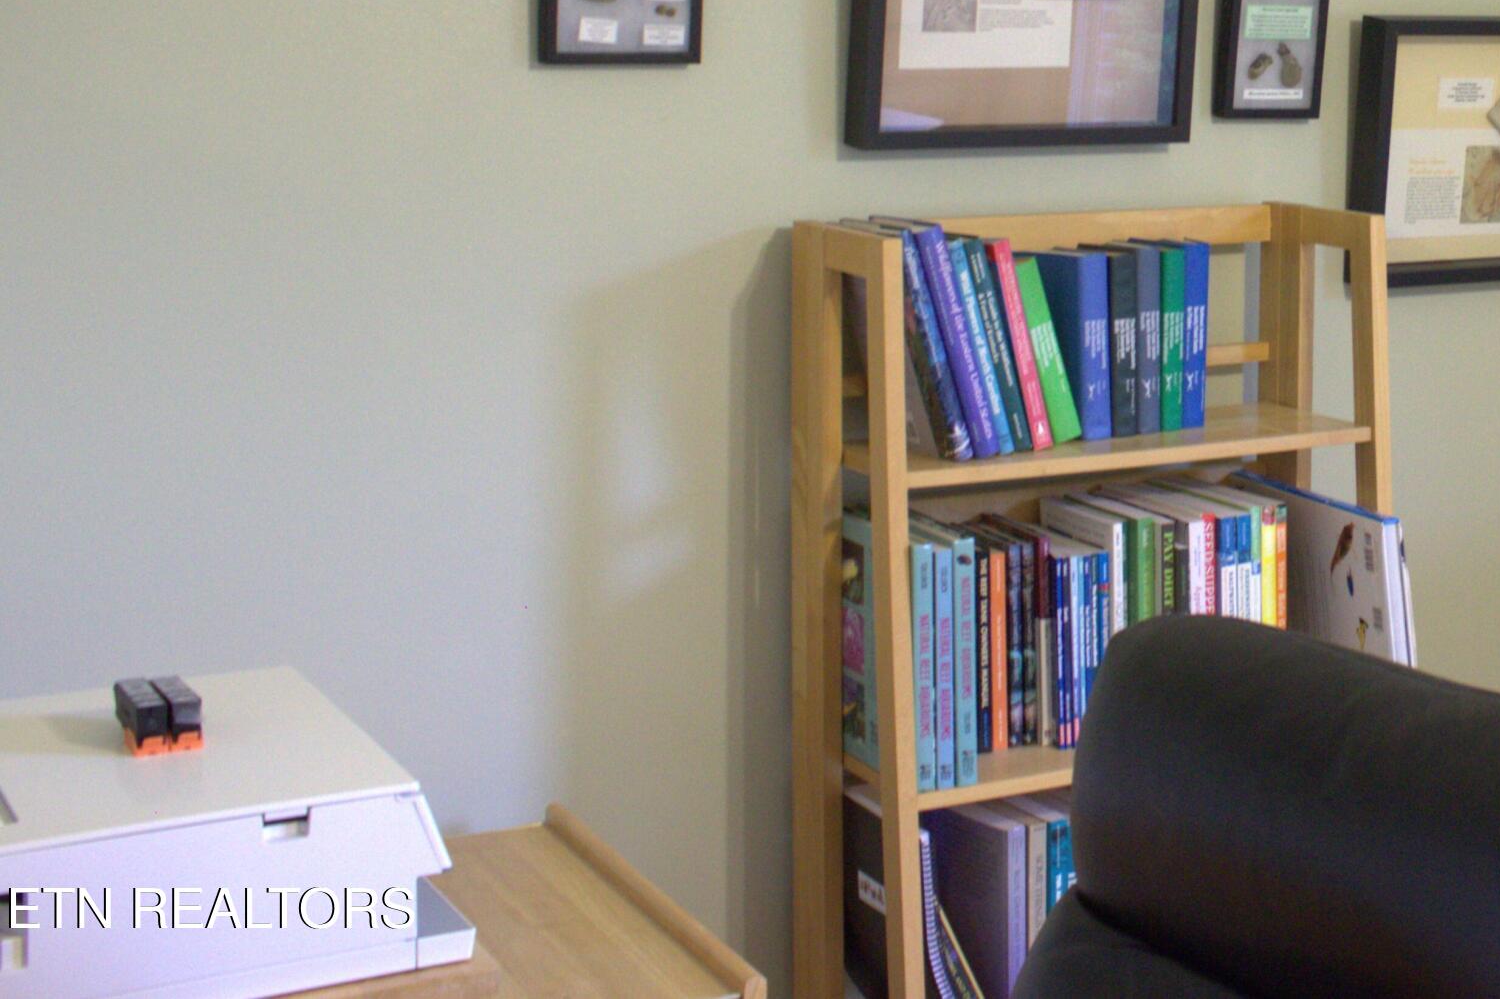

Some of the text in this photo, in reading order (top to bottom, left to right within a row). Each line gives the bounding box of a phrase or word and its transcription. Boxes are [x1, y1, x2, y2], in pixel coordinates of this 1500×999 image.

[931, 242, 959, 303] Wildflowers
[958, 270, 973, 296] Wild
[947, 300, 962, 315] of
[954, 315, 966, 332] the
[964, 296, 983, 337] Flowers
[959, 333, 976, 372] Eastern
[976, 346, 993, 376] North
[969, 373, 986, 408] United
[984, 375, 1003, 415] Carolina
[978, 408, 994, 440] States
[1164, 532, 1174, 608] PAY DIRT
[1205, 522, 1215, 615] SEED SUPPE
